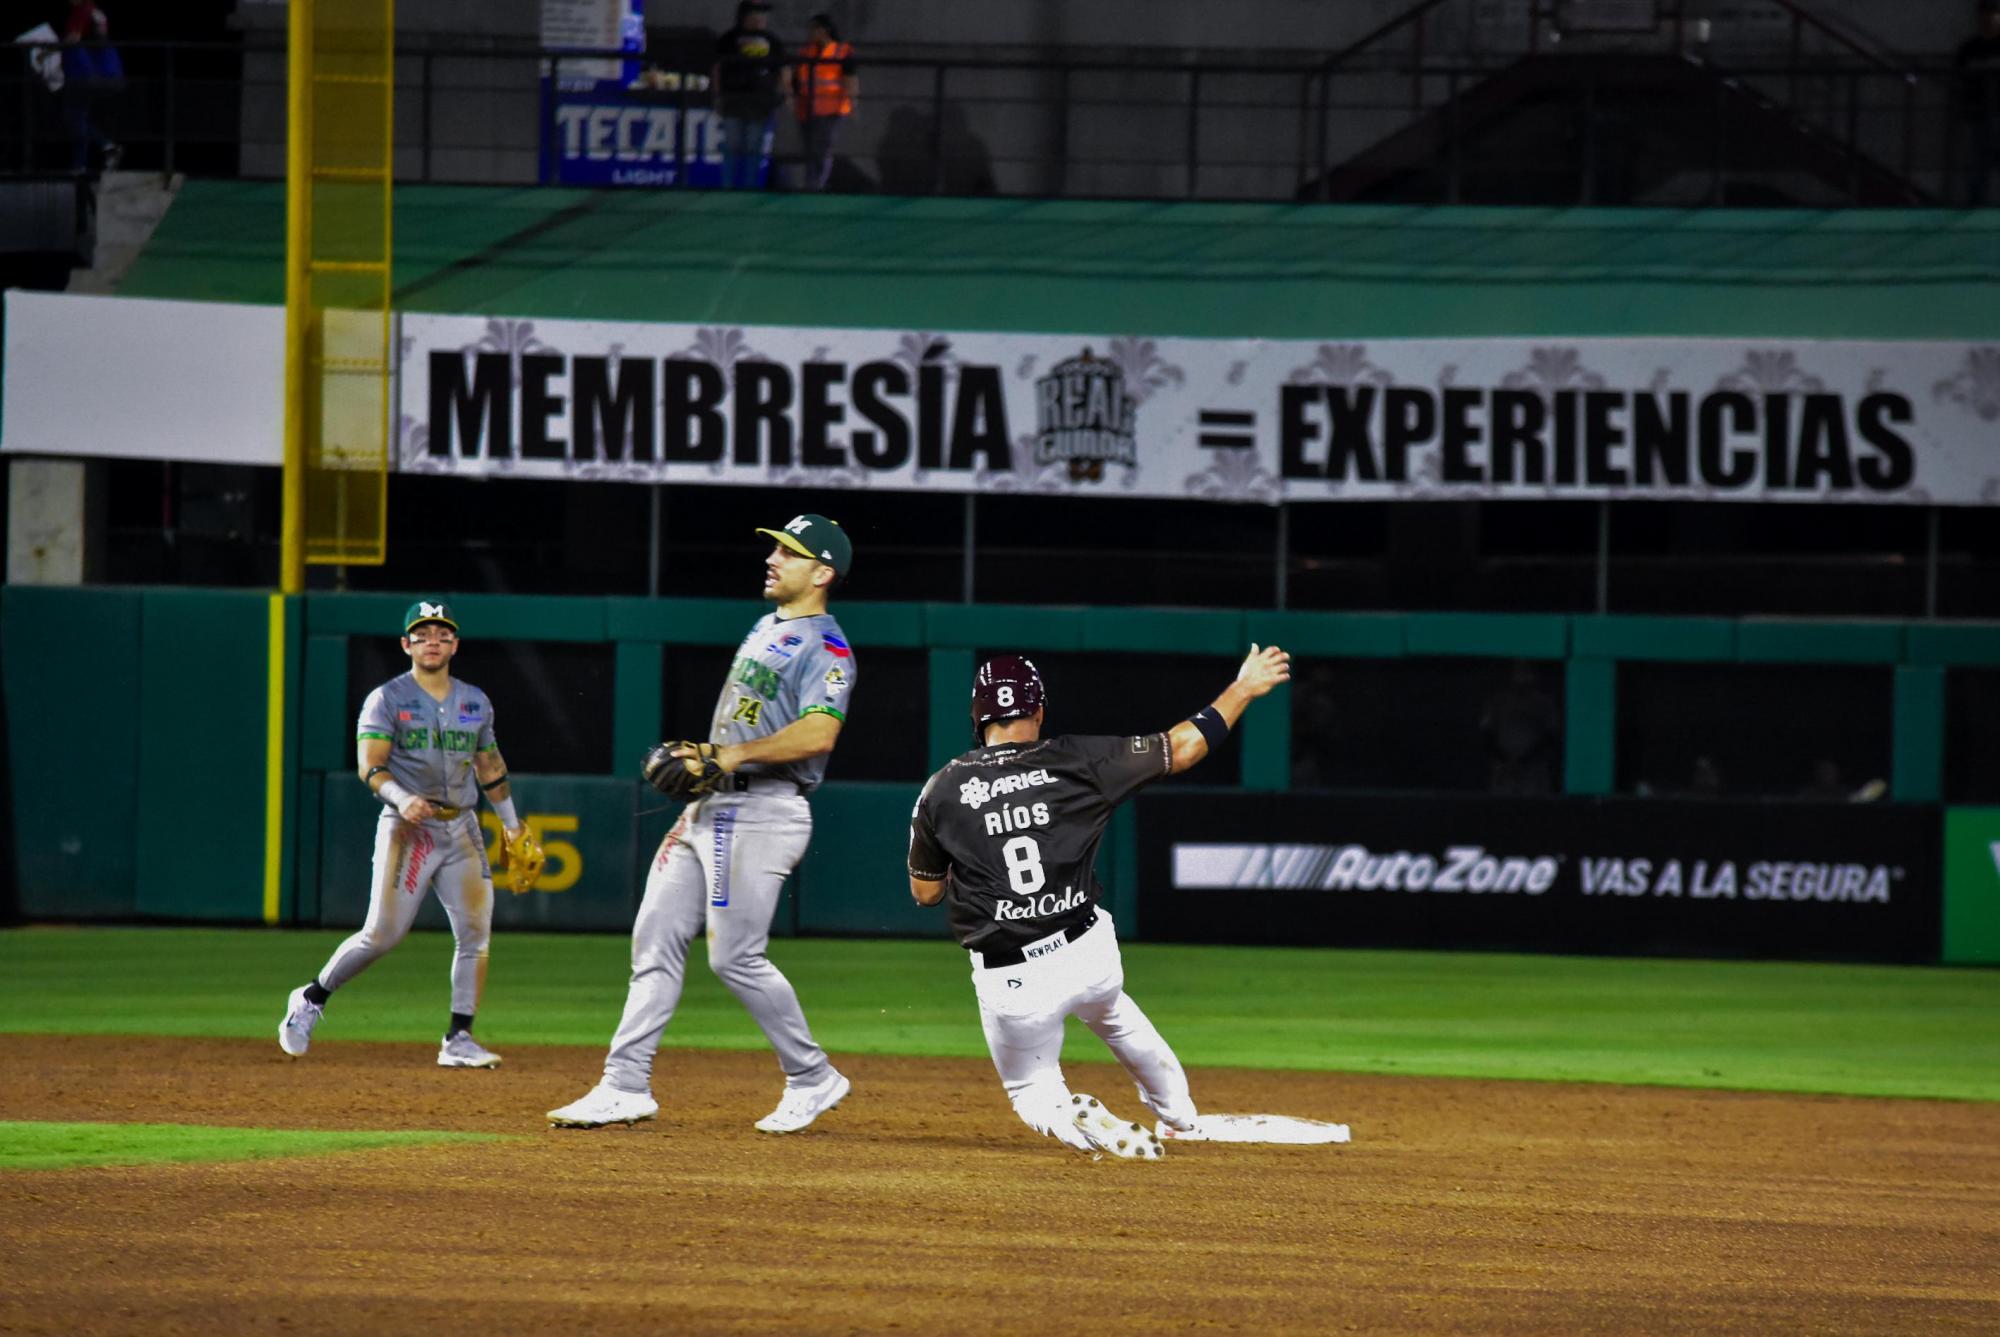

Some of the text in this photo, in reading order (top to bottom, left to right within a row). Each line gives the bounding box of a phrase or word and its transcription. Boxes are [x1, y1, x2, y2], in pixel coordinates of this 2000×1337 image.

[427, 344, 1012, 471] MEMBRESÍA
[1279, 384, 1917, 492] EXPERIENCIAS
[731, 696, 764, 727] 74
[996, 685, 1015, 707] 8
[990, 769, 1059, 798] ARIEL
[984, 803, 1051, 836] RÍOS
[1002, 835, 1047, 896] 8
[1323, 842, 1891, 903] AutoZone VAS A LA SEGURA
[994, 886, 1088, 922] Red Cola
